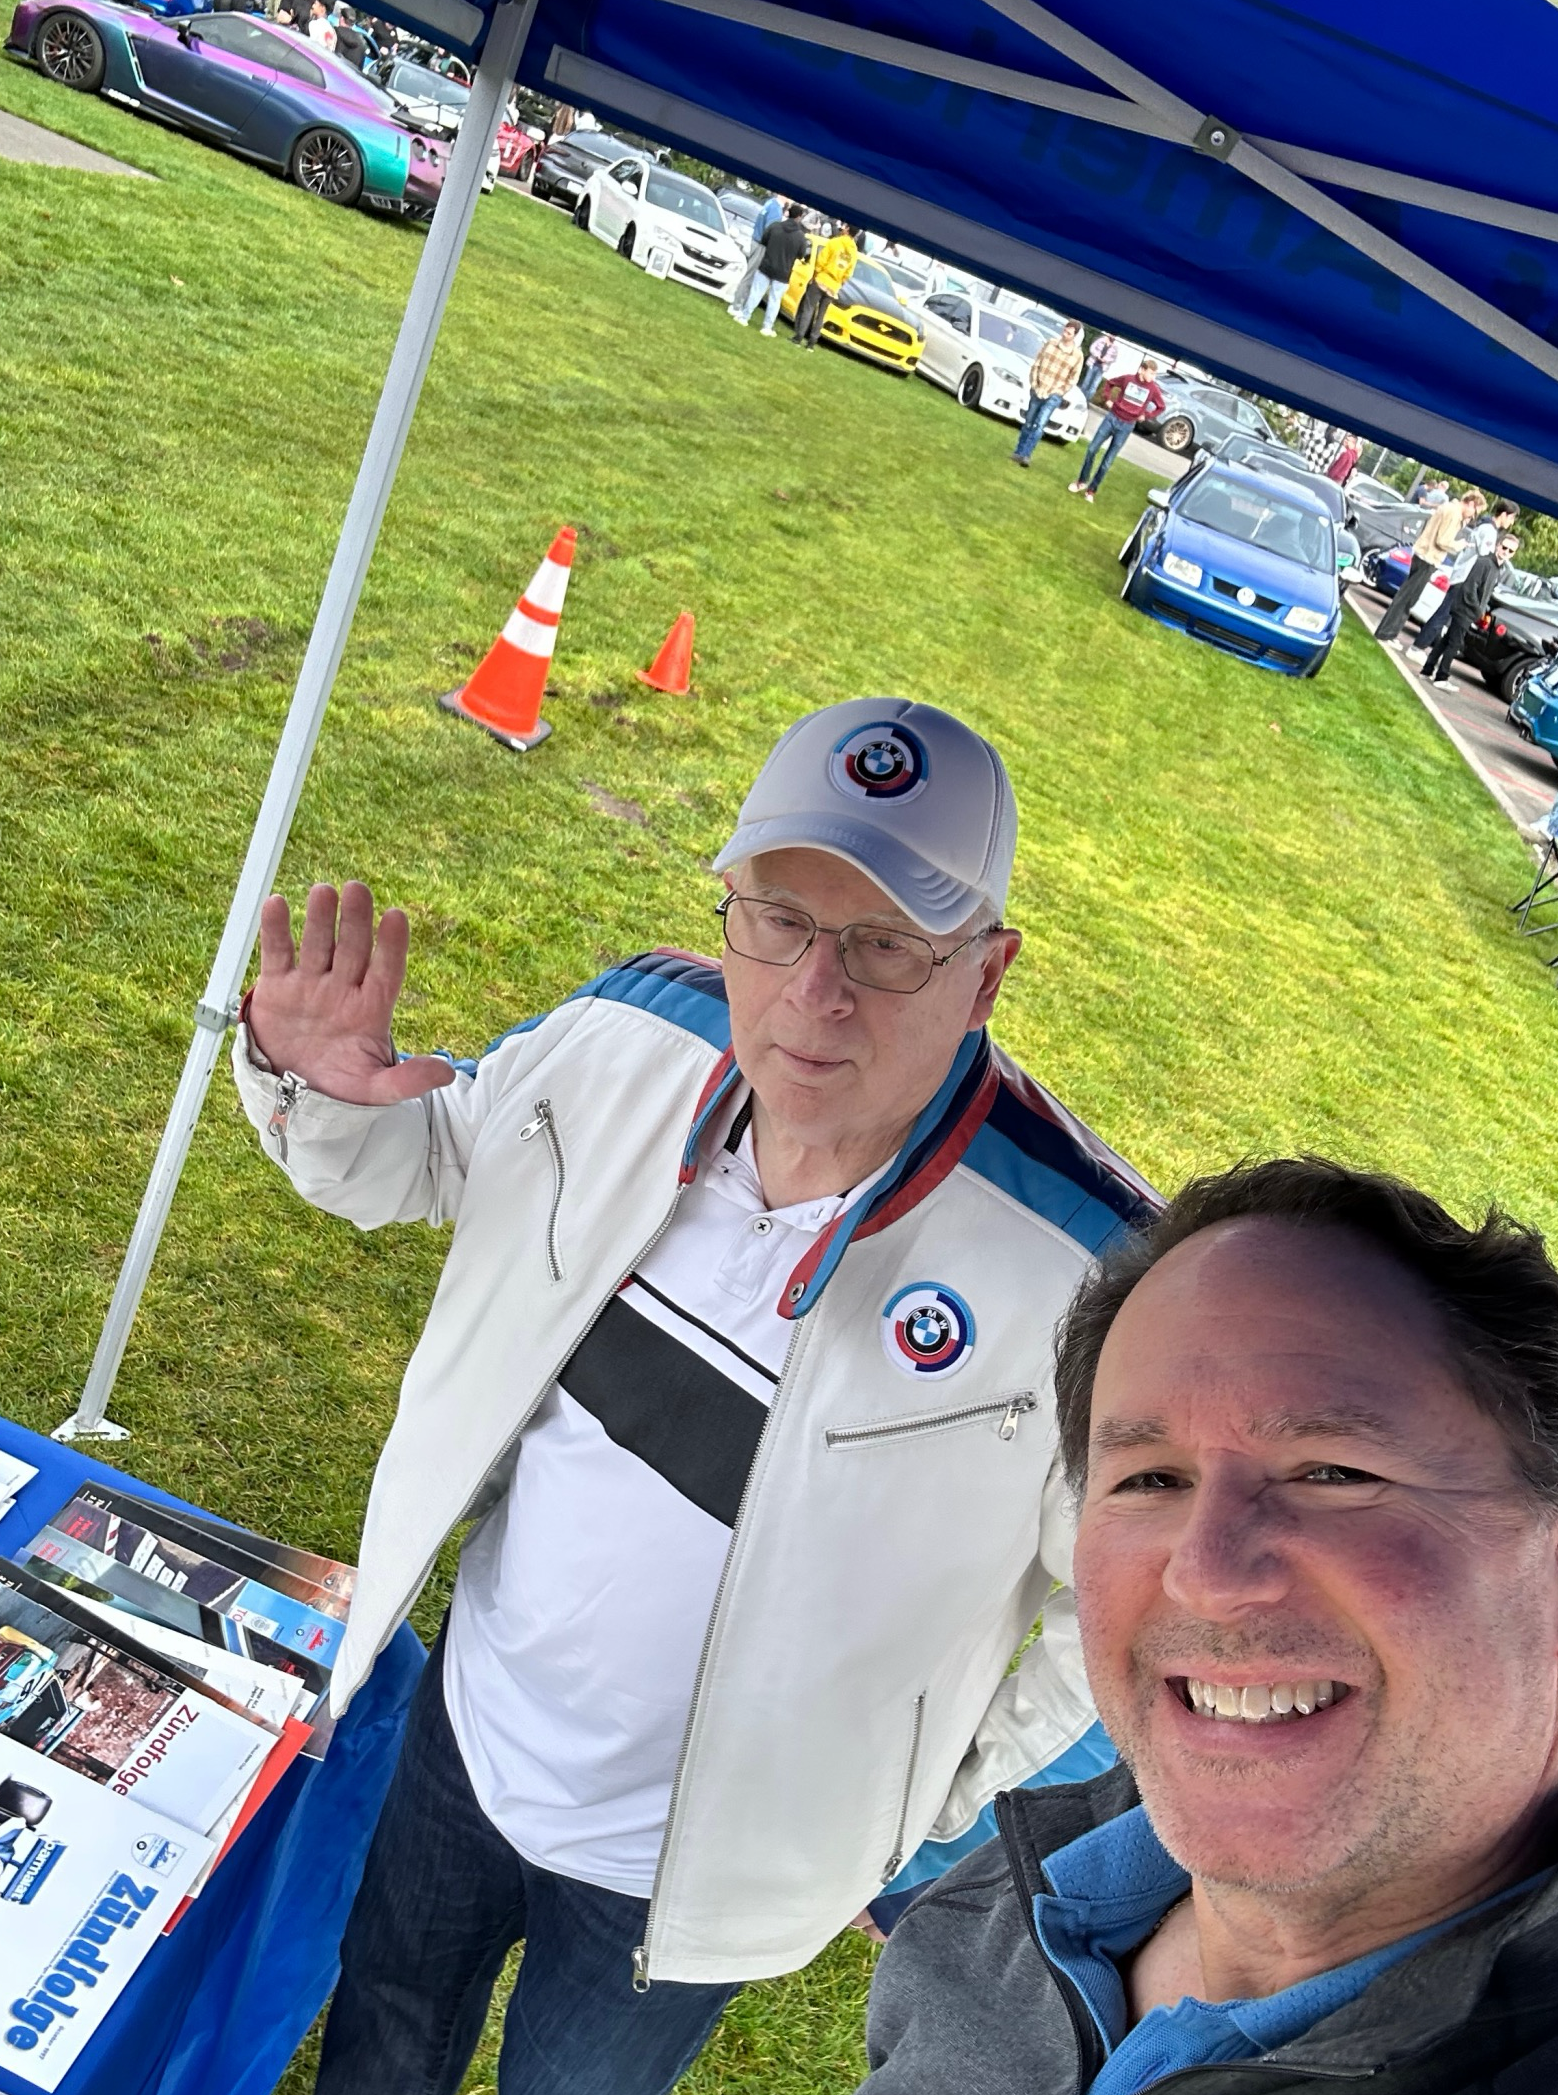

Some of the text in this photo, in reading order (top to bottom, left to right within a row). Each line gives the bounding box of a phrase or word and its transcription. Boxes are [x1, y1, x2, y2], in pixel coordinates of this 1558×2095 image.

[864, 743, 904, 762] BMW
[913, 1309, 949, 1330] BMW
[114, 1702, 199, 1796] Zündfolge
[13, 1840, 55, 1900] parmalat
[6, 1873, 158, 2050] Zündfolge
